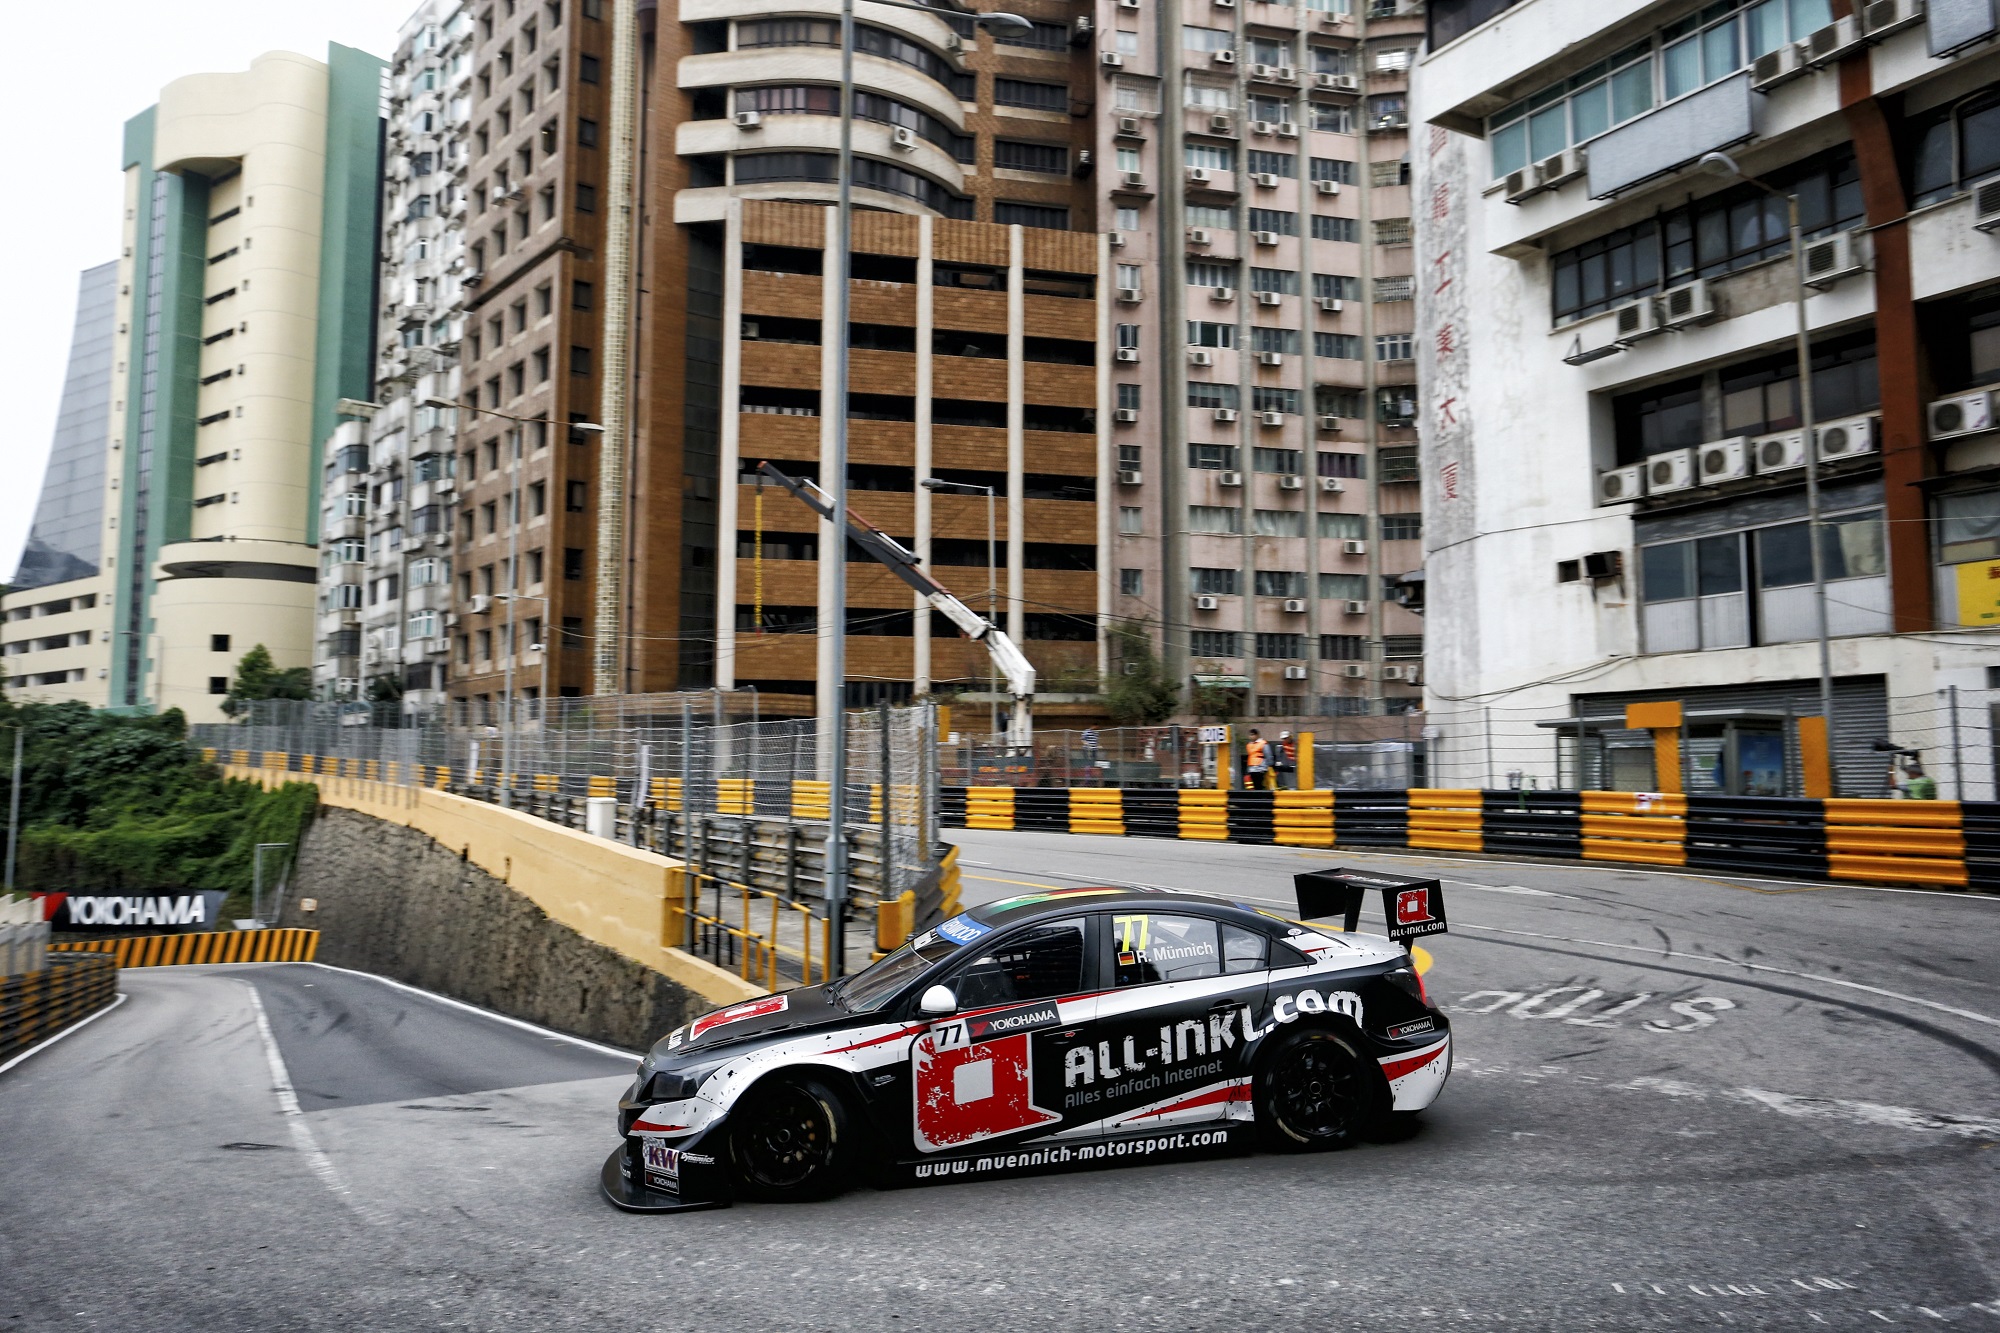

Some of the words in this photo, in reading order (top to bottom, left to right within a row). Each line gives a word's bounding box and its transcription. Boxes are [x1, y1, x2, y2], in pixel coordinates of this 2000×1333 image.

[66, 895, 206, 925] YOKOHAMA
[1113, 914, 1148, 952] 77
[1136, 948, 1152, 963] R.
[1153, 942, 1214, 961] Münnich
[989, 1009, 1057, 1031] YOKOHAMA
[1400, 1020, 1431, 1034] YOKOHAMA
[936, 1023, 963, 1047] 77
[1065, 1088, 1101, 1108] Alles
[1106, 1073, 1160, 1099] einfach
[1165, 1059, 1223, 1085] Internet
[649, 1146, 678, 1171] KW
[915, 1130, 1228, 1178] www.muennich-motorsport.com
[653, 1177, 678, 1190] YOKOHAMA
